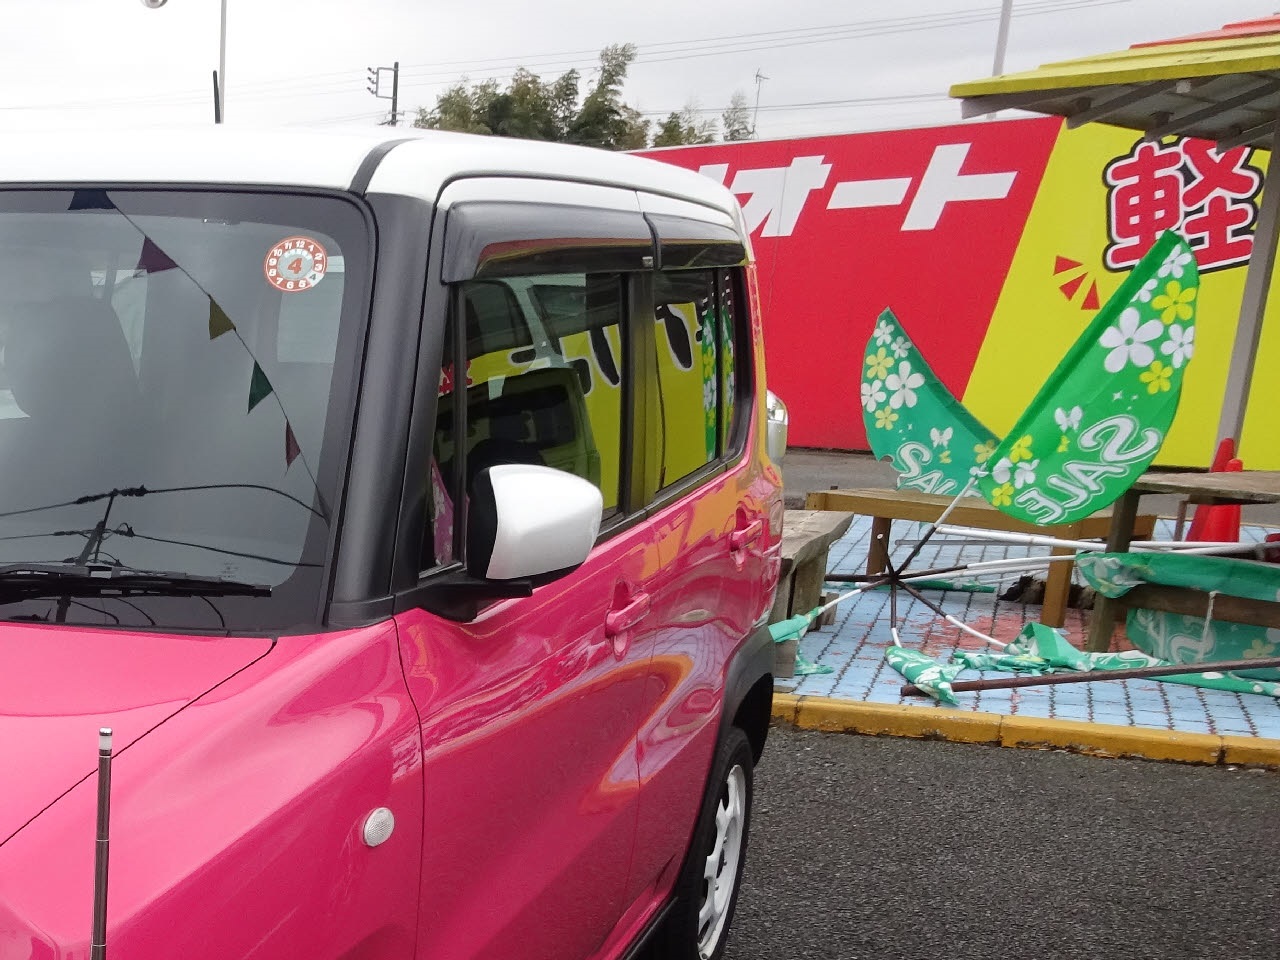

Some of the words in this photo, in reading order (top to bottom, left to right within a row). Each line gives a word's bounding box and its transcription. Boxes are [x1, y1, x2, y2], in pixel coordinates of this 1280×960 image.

[284, 241, 293, 249] 11
[308, 244, 315, 252] 1
[273, 248, 283, 257] 10
[314, 252, 322, 260] 2
[268, 258, 277, 266] 9
[287, 257, 303, 275] 4
[314, 263, 322, 271] 3
[268, 269, 277, 277] 8
[309, 273, 317, 281] 4
[276, 277, 283, 285] 7
[286, 281, 294, 289] 6
[298, 280, 306, 288] 5
